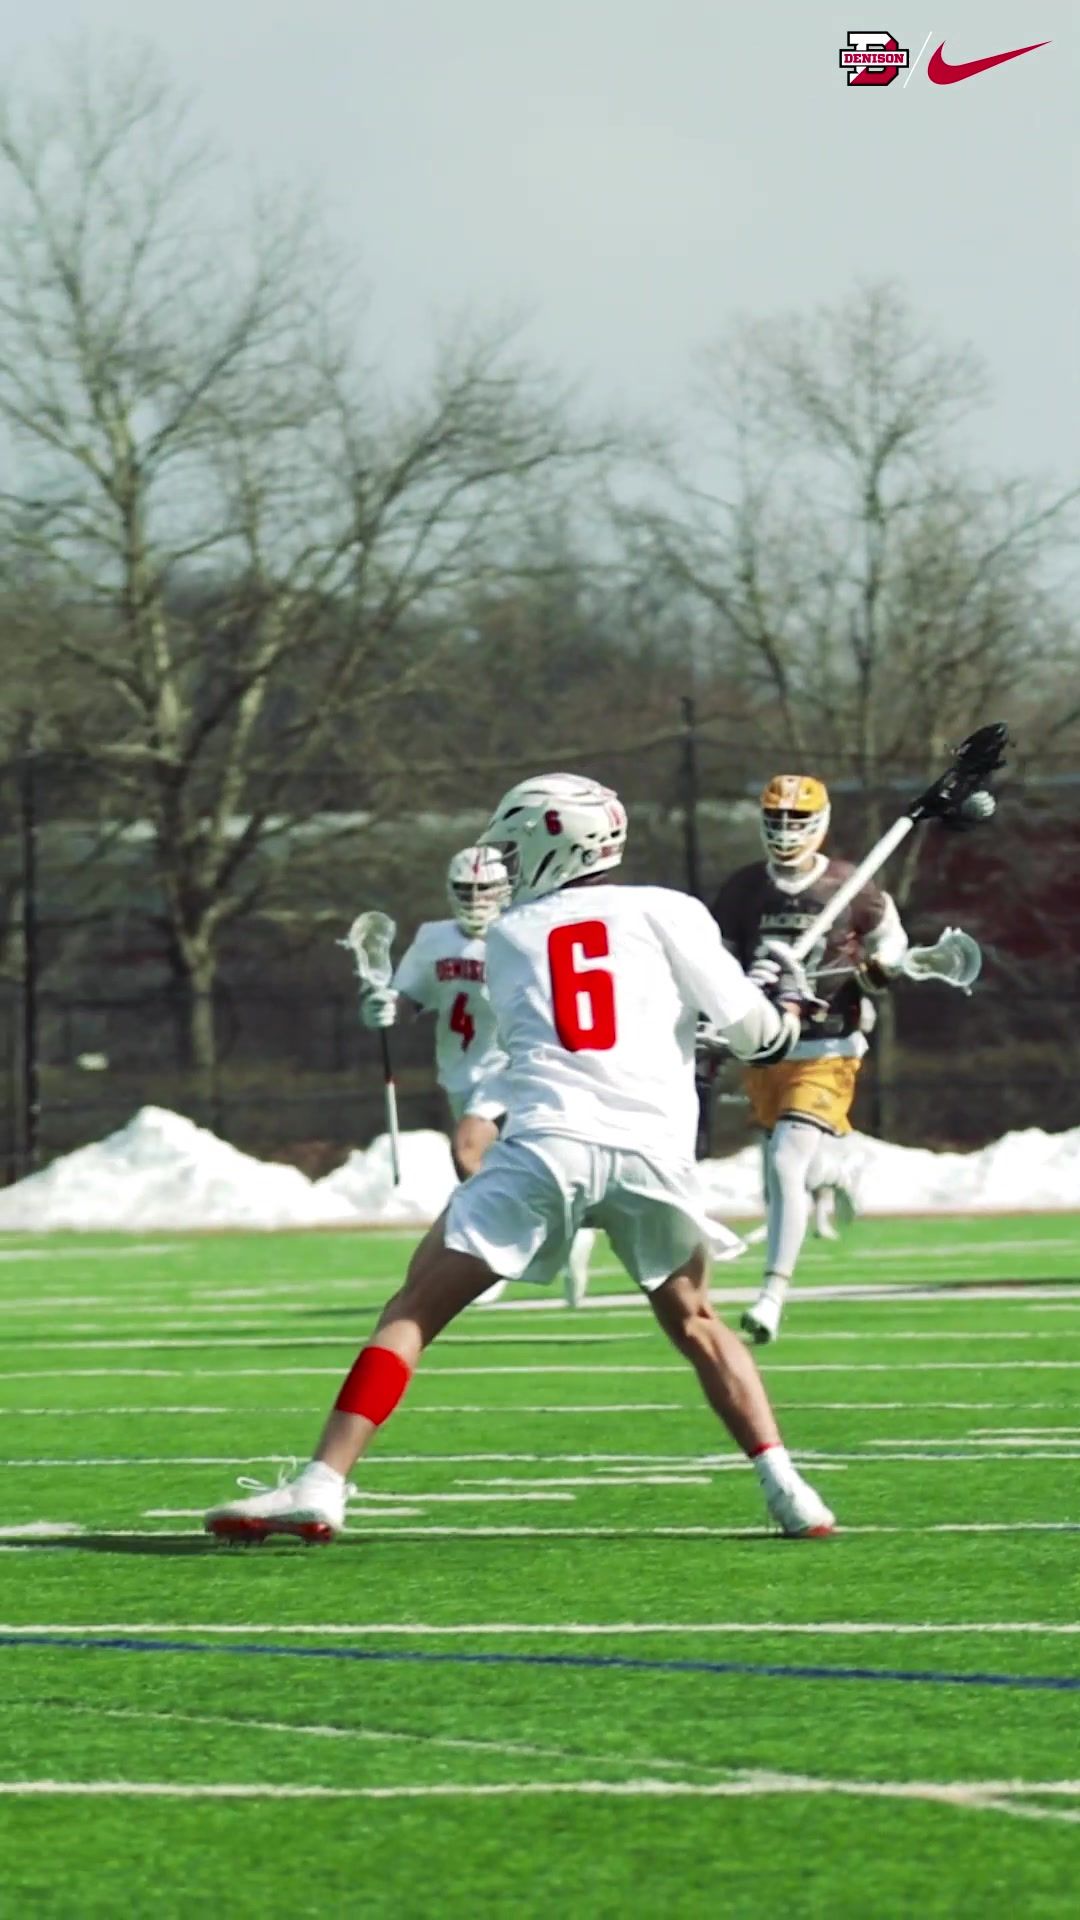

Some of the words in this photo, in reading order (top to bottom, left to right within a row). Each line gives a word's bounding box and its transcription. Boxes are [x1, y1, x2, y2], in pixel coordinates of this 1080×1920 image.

[544, 809, 564, 836] 6
[547, 920, 616, 1053] 6
[449, 992, 475, 1052] 4
